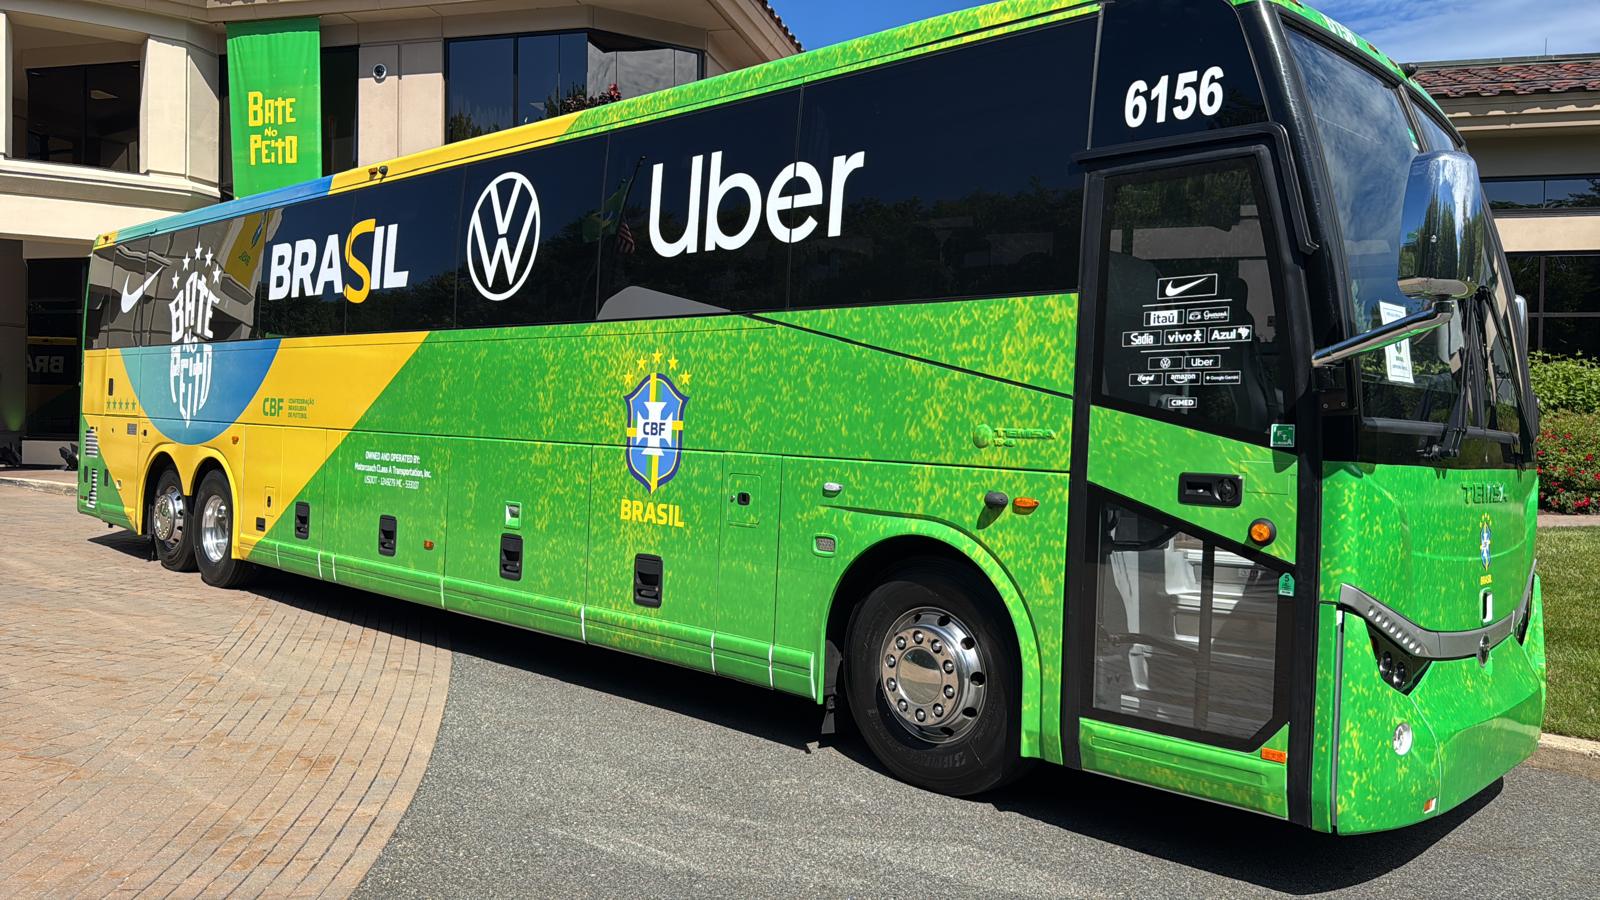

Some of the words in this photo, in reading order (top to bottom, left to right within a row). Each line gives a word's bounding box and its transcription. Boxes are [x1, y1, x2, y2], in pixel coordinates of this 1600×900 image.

[1124, 66, 1224, 128] 6156
[648, 150, 865, 258] Uber
[268, 218, 409, 304] BRASIL
[168, 271, 220, 343] BATE
[1130, 333, 1154, 346] Sadia
[1167, 331, 1191, 343] vivo
[1211, 327, 1236, 341] Azul
[1191, 358, 1213, 367] Uber
[1170, 373, 1196, 381] amazon
[263, 397, 284, 417] CBF
[642, 421, 666, 436] CBF
[620, 499, 685, 528] BRASIL
